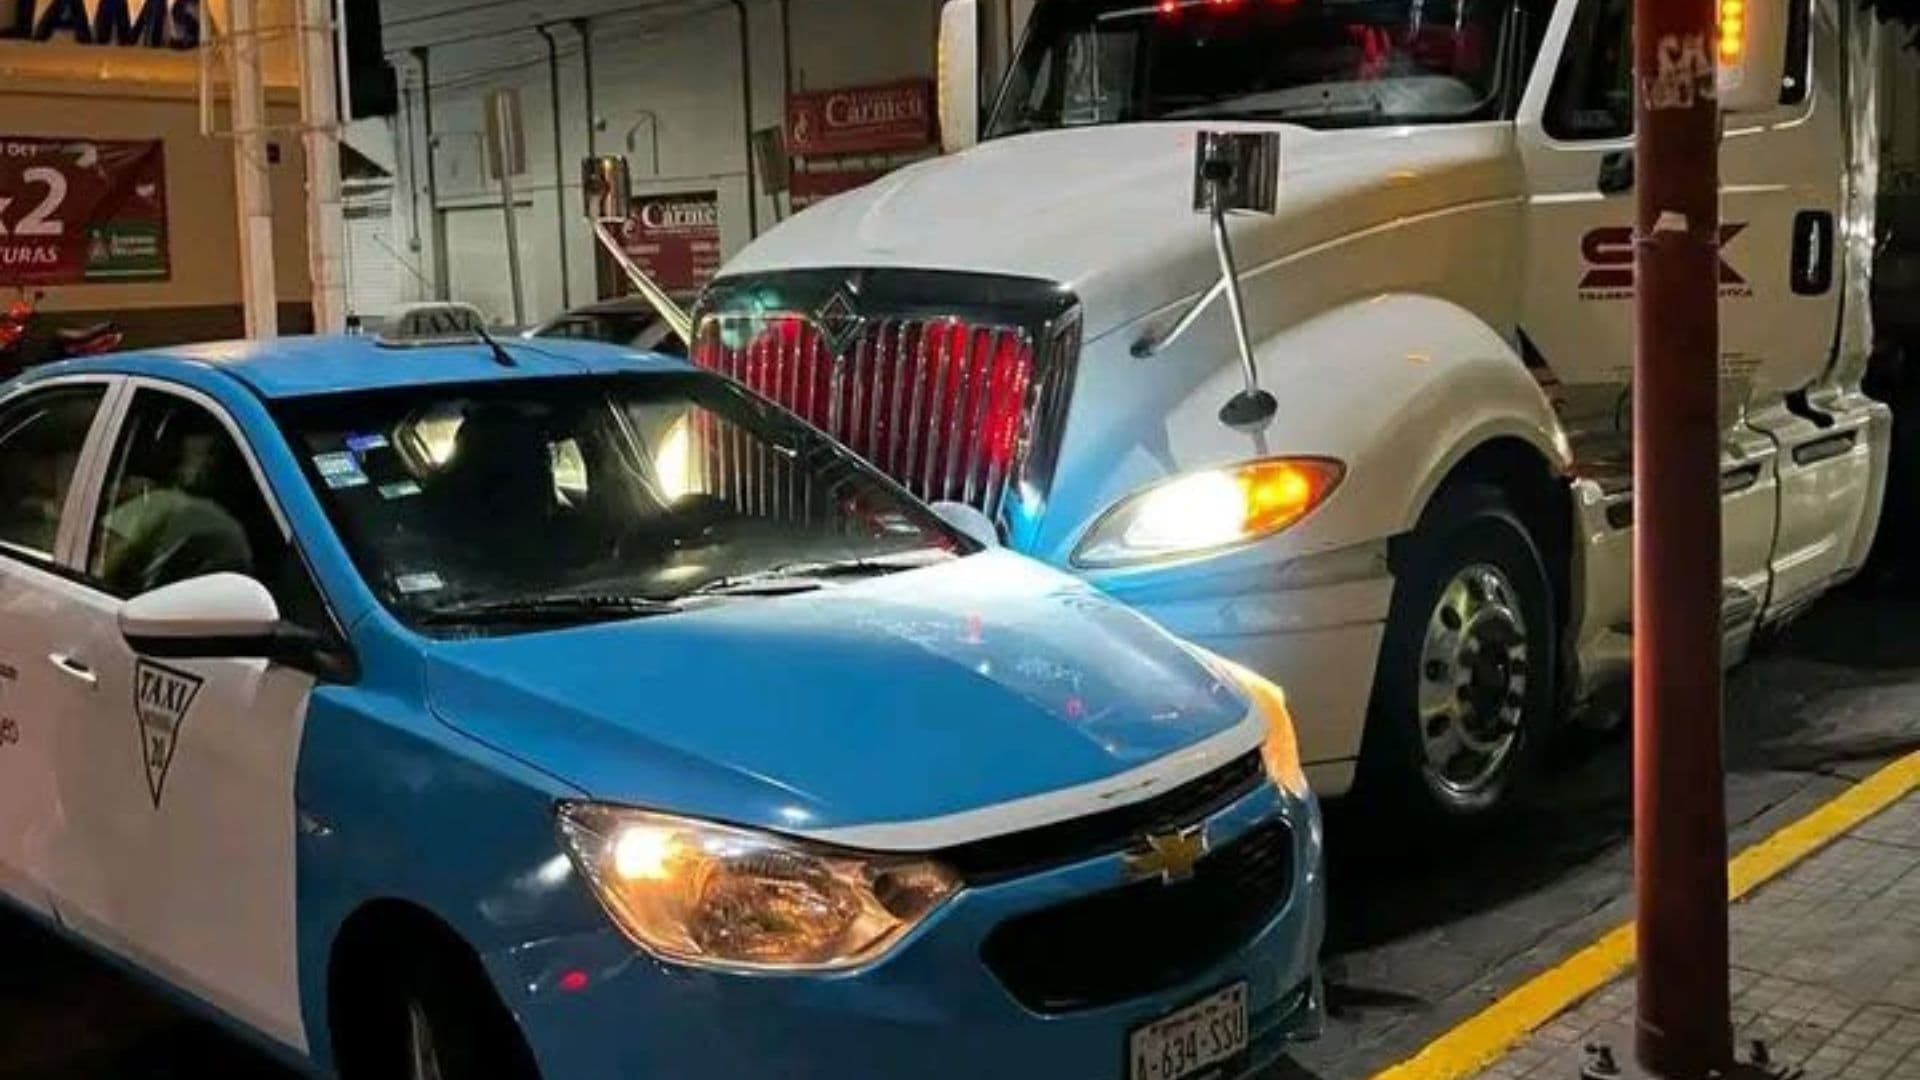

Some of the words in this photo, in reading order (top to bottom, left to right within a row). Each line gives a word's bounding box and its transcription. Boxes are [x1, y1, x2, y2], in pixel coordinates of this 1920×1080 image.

[0, 243, 58, 265] URAS
[404, 311, 472, 336] TAXI
[140, 670, 187, 713] TAXI
